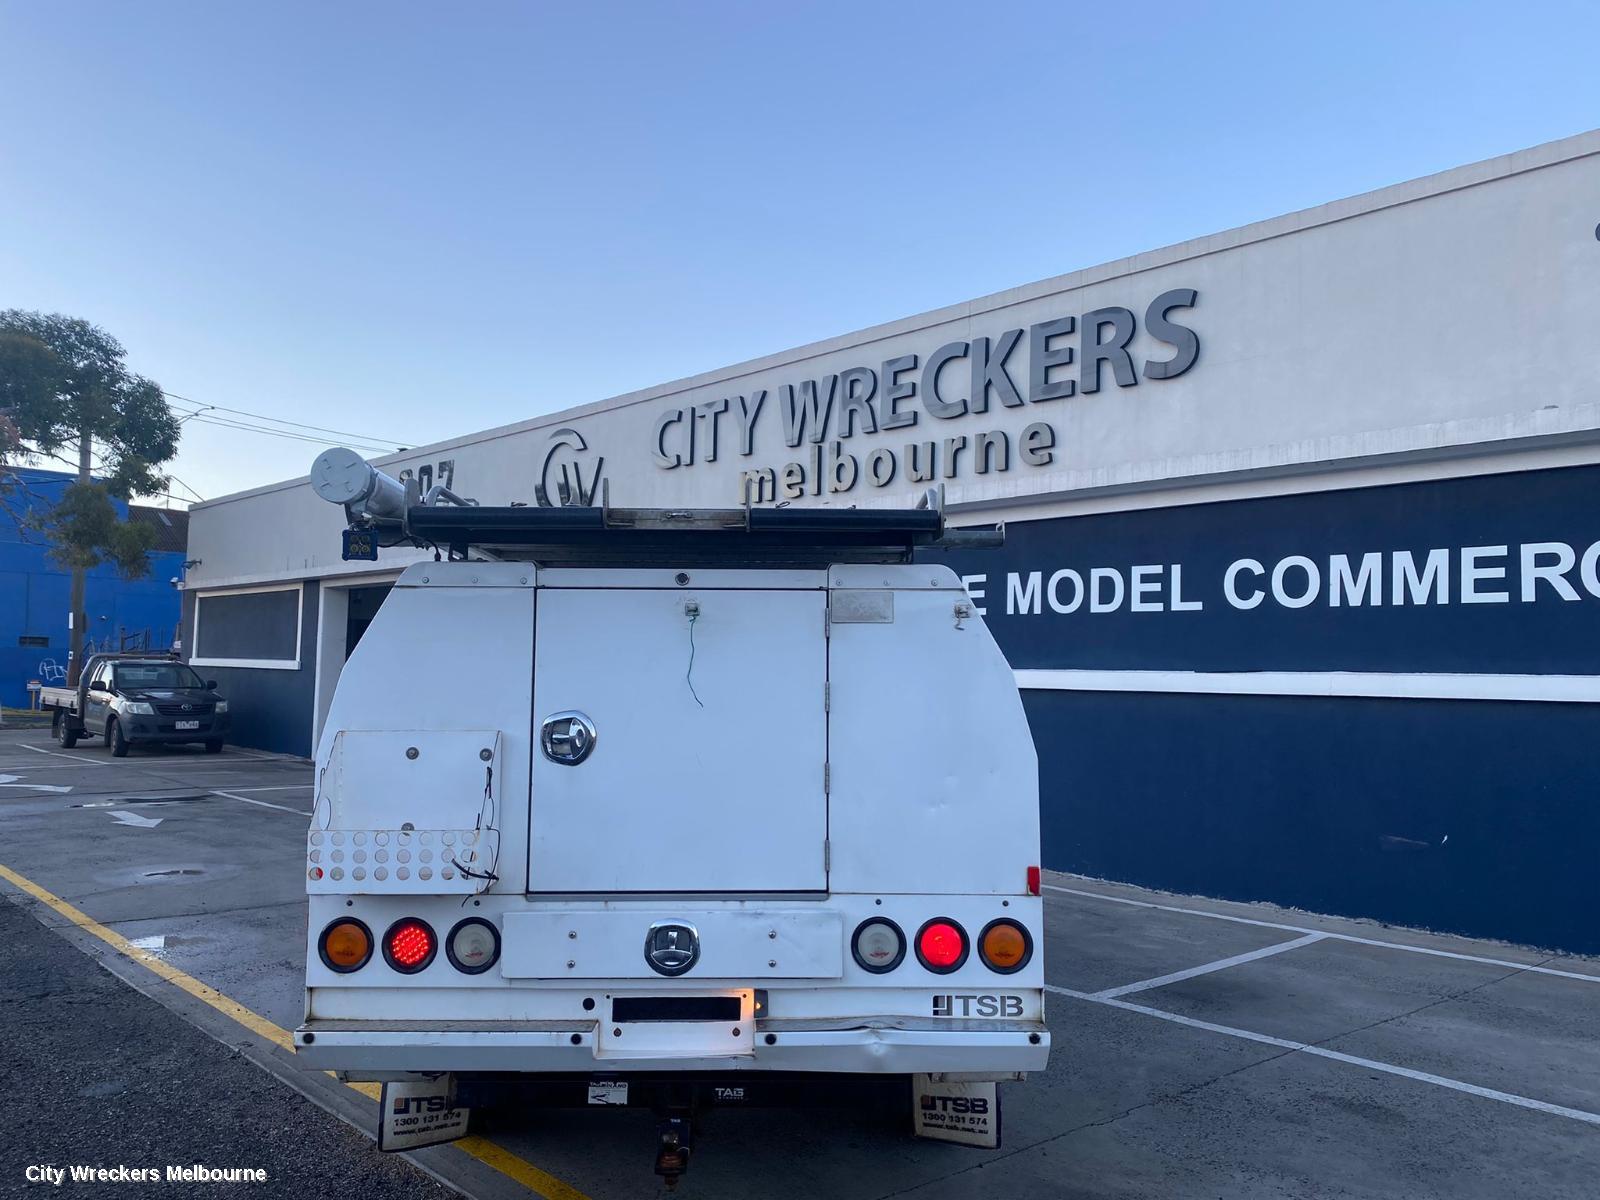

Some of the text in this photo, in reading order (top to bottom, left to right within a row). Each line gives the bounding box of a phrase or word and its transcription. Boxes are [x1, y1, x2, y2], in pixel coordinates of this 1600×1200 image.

[651, 288, 1200, 470] CITY WRECKERS
[739, 421, 1056, 505] melbourne
[1006, 564, 1203, 615] MODEL
[714, 1087, 744, 1097] TAG
[410, 1095, 449, 1113] TS
[393, 1117, 419, 1127] 1300
[423, 1114, 440, 1124] 131
[923, 1112, 987, 1126] 1300 131 574
